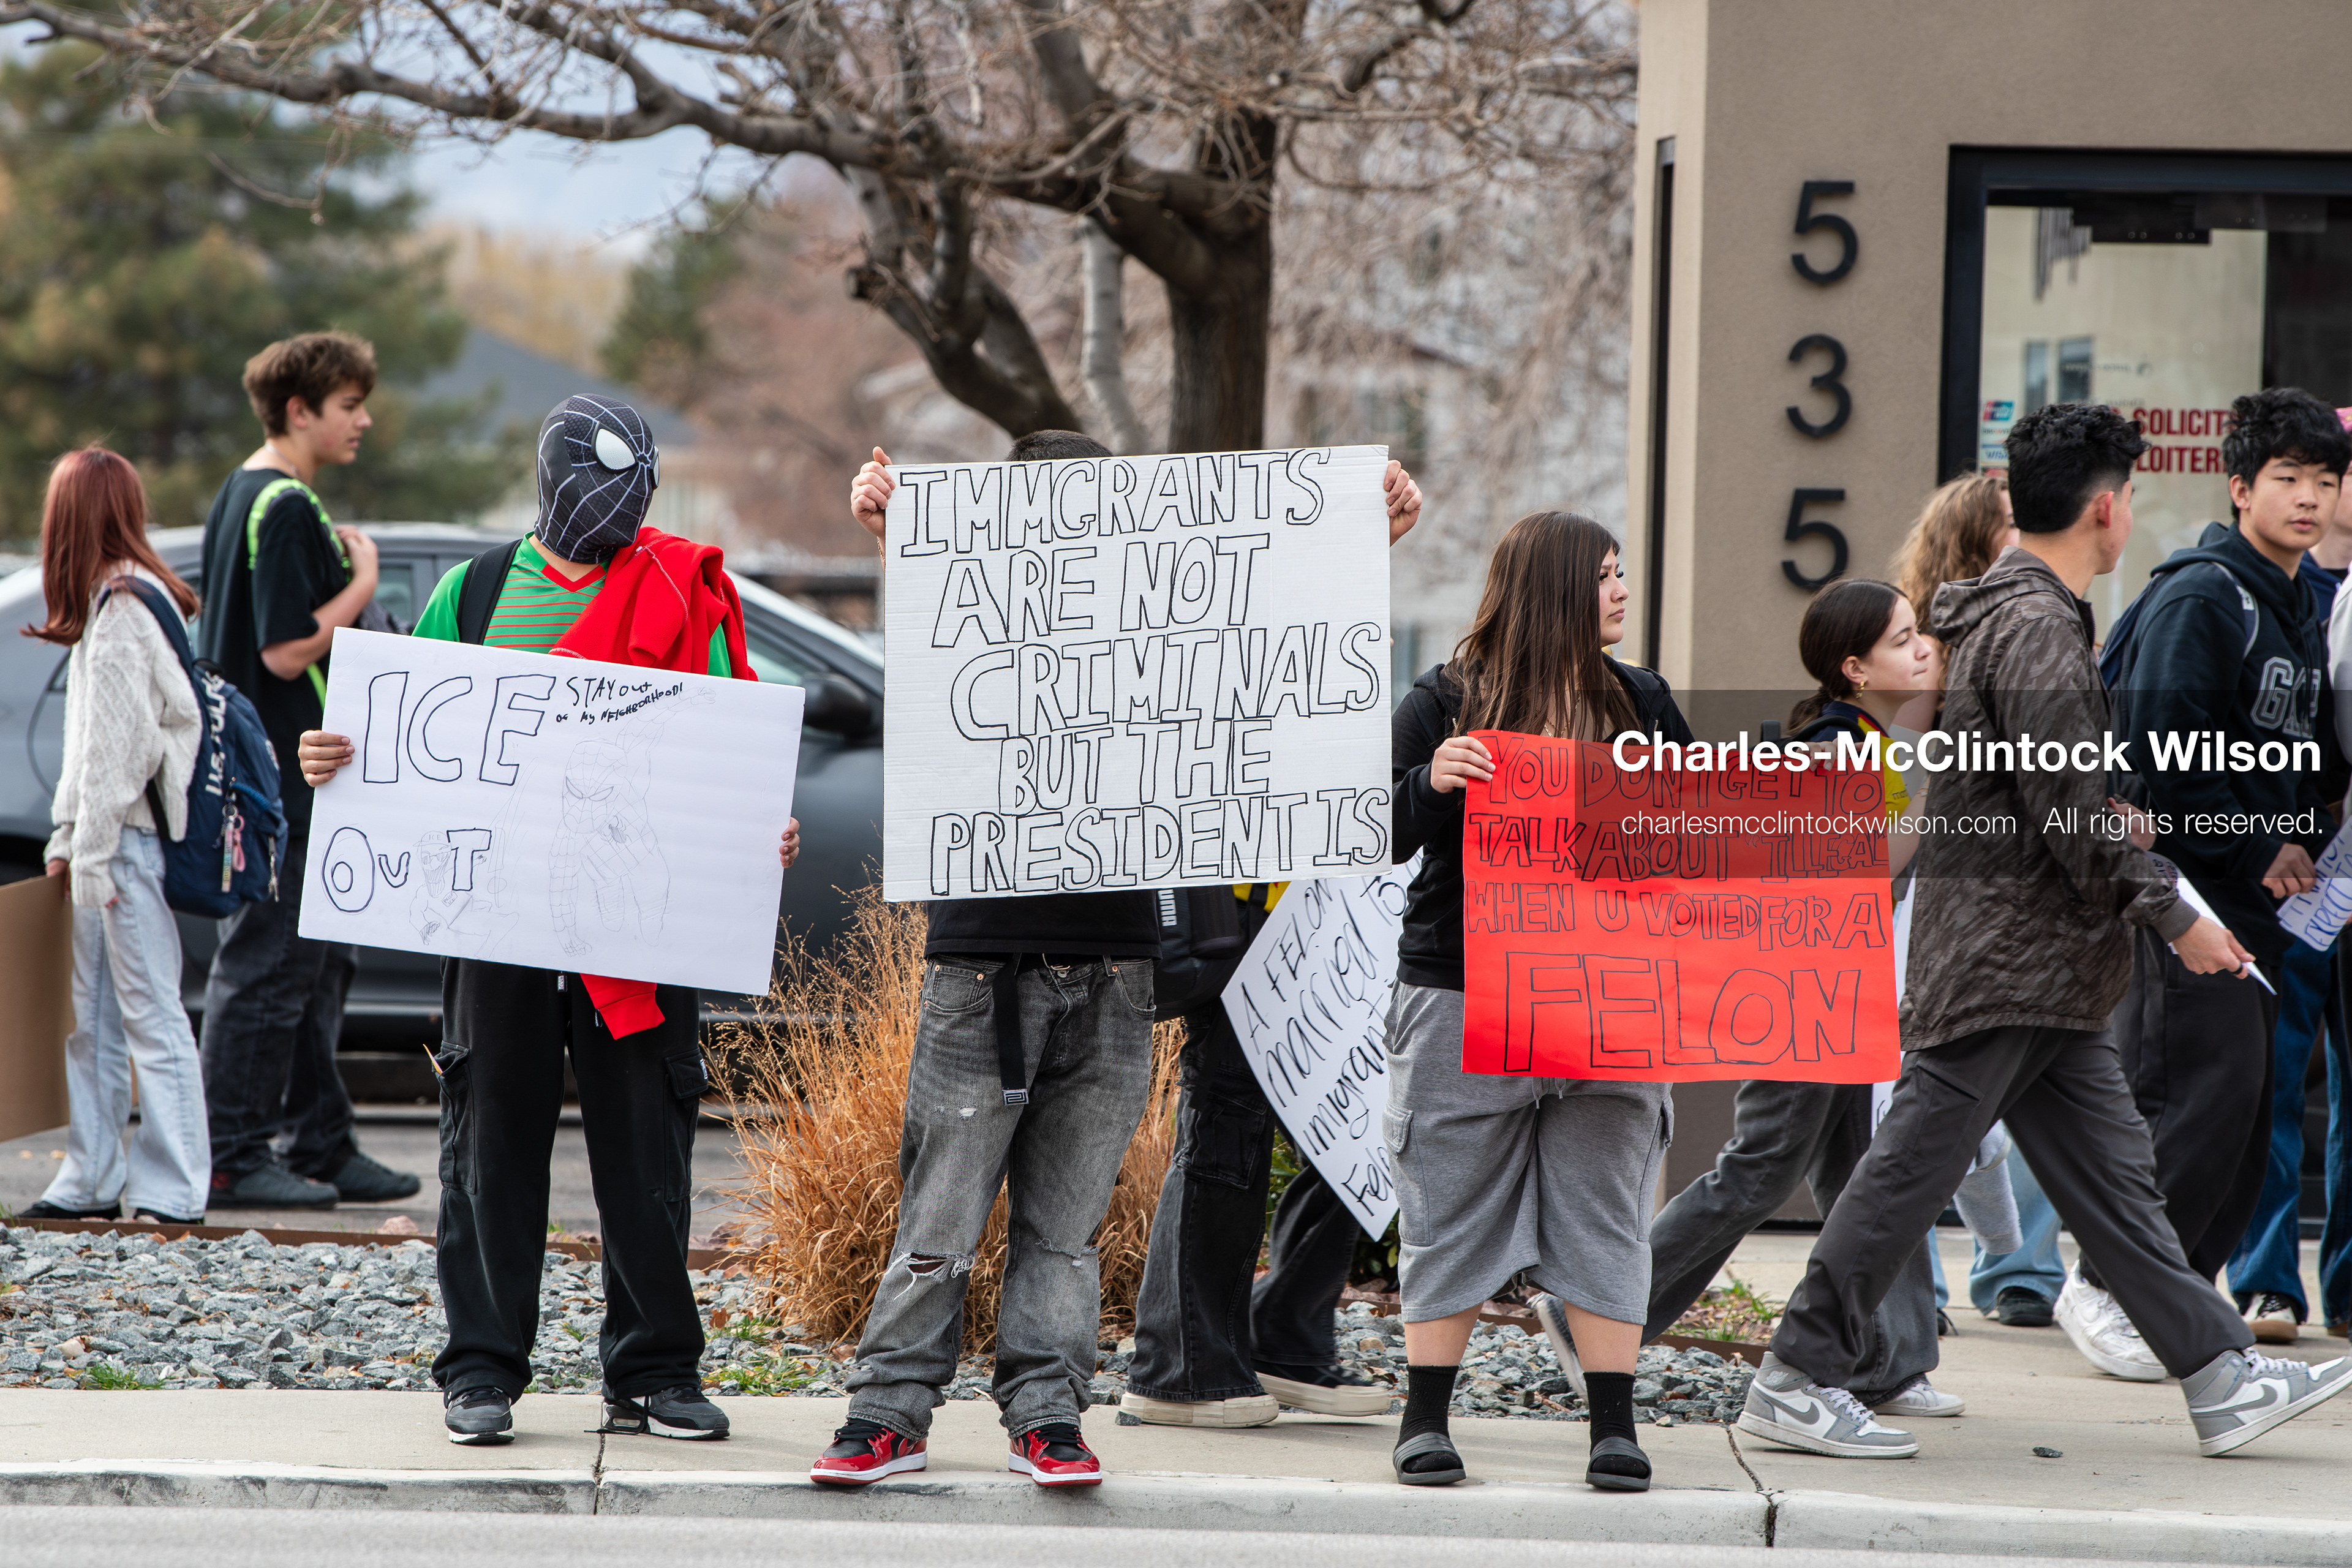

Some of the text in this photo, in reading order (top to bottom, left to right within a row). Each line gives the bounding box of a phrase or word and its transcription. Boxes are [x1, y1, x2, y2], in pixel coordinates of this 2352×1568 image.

[2133, 407, 2237, 436] SOLICIT
[2136, 446, 2228, 473] LOITER
[900, 447, 1330, 557] IMMGRANTS
[932, 533, 1270, 649] ARE NOT
[566, 676, 616, 708] STAY
[951, 622, 1381, 741] CRIMINALS
[363, 671, 557, 786] ICE
[1000, 719, 1273, 816] BUT THE
[1479, 736, 1569, 804] YOU
[1717, 755, 1807, 800] GET
[1814, 766, 1883, 816] TO
[931, 788, 1390, 896] PRESIDENT IS
[1469, 813, 1586, 873] TALK
[1581, 822, 1739, 882] ABOUT
[1158, 889, 1177, 927] UMA
[1467, 880, 1887, 951] WHEN U VOTED FOR A
[1242, 982, 1270, 1055] A
[1265, 889, 1379, 1108] married
[1504, 951, 1861, 1072] FELON
